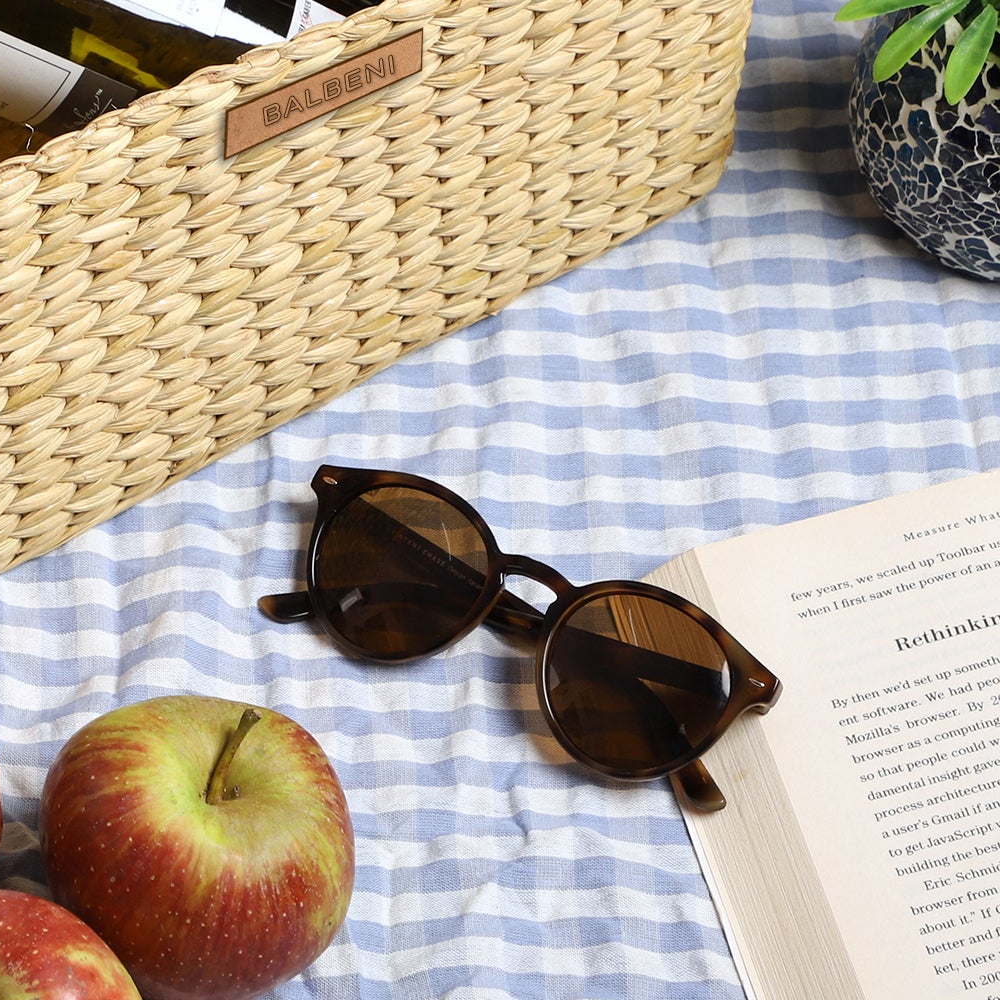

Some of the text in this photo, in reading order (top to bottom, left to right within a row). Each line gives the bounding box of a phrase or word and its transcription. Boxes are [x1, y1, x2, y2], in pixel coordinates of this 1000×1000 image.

[262, 55, 396, 127] BALBENI
[903, 511, 1000, 542] Measure What
[790, 590, 813, 602] few
[815, 581, 854, 598] years,
[855, 575, 874, 585] we
[876, 561, 917, 580] scaled
[918, 558, 935, 568] up
[936, 544, 986, 563] Toolbar
[797, 606, 832, 619] when
[833, 601, 840, 611] I
[841, 595, 868, 609] first
[869, 588, 893, 601] saw
[896, 582, 917, 594] the
[918, 571, 957, 590] power
[960, 564, 973, 576] of
[975, 562, 992, 572] an
[831, 698, 848, 709] By
[851, 690, 881, 704] then
[913, 675, 934, 687] set
[935, 671, 952, 681] up
[838, 715, 860, 727] ent
[862, 699, 922, 721] software.
[924, 691, 945, 703] We
[947, 682, 974, 697] had
[905, 709, 961, 729] browser.
[966, 701, 984, 713] By
[851, 717, 1000, 764] browser as a computing
[859, 773, 875, 783] so
[877, 764, 905, 778] that
[905, 752, 949, 773] people
[951, 740, 987, 758] could
[867, 759, 1000, 802] damental insight gave
[874, 801, 925, 823] process
[881, 831, 891, 840] a
[931, 807, 971, 826] Gmail
[971, 803, 982, 815] if
[888, 848, 903, 858] to
[905, 841, 926, 857] get
[927, 823, 995, 849] JavaScript
[895, 856, 951, 877] building
[951, 851, 973, 863] the
[923, 877, 953, 891] Eric
[910, 887, 999, 916] browser from
[919, 918, 957, 936] about
[980, 907, 993, 919] If
[925, 929, 994, 955] better and
[933, 953, 997, 976] ket, there
[962, 980, 978, 991] In
